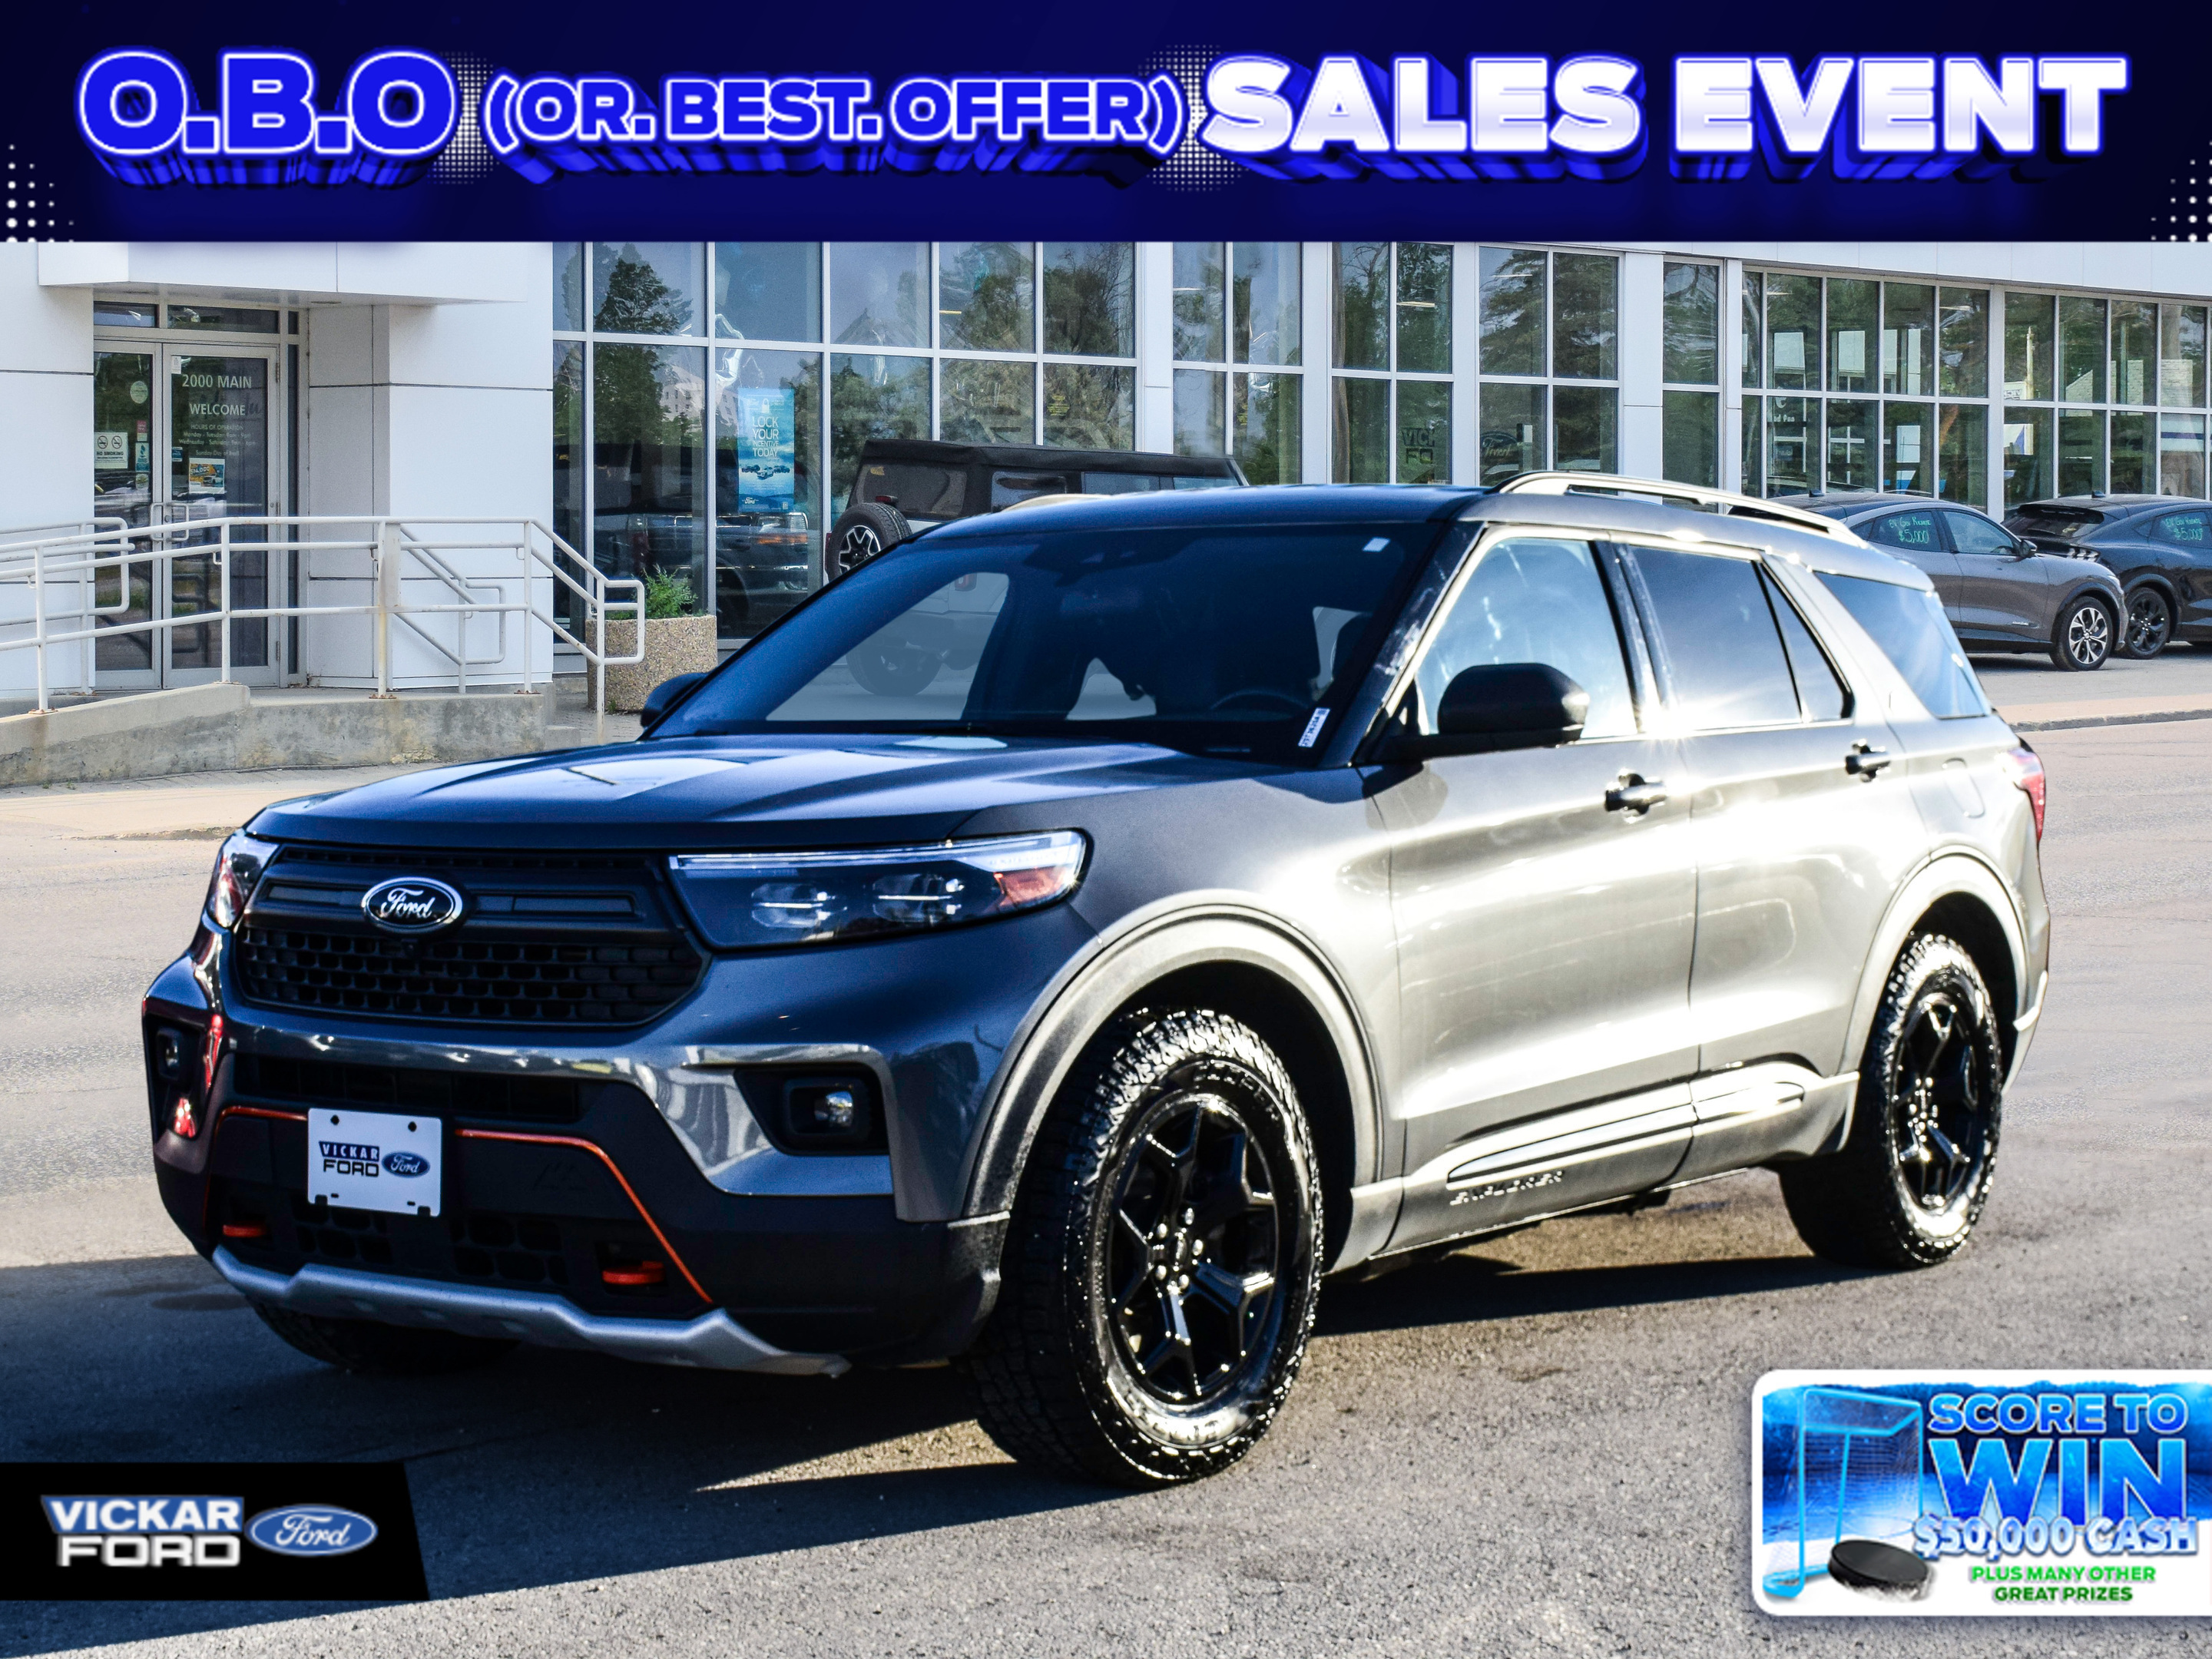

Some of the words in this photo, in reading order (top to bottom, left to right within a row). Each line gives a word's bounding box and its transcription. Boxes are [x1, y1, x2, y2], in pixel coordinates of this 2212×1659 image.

[182, 374, 213, 388] 2000
[217, 375, 252, 389] MAIN
[189, 403, 246, 416] WELCOME
[753, 416, 779, 428] LOCK
[752, 429, 779, 440] YOUR
[753, 448, 778, 458] TODAY
[376, 887, 435, 919] Ford
[323, 1144, 379, 1161] VICKAR
[323, 1158, 379, 1177] FORD
[390, 1154, 421, 1174] Ford
